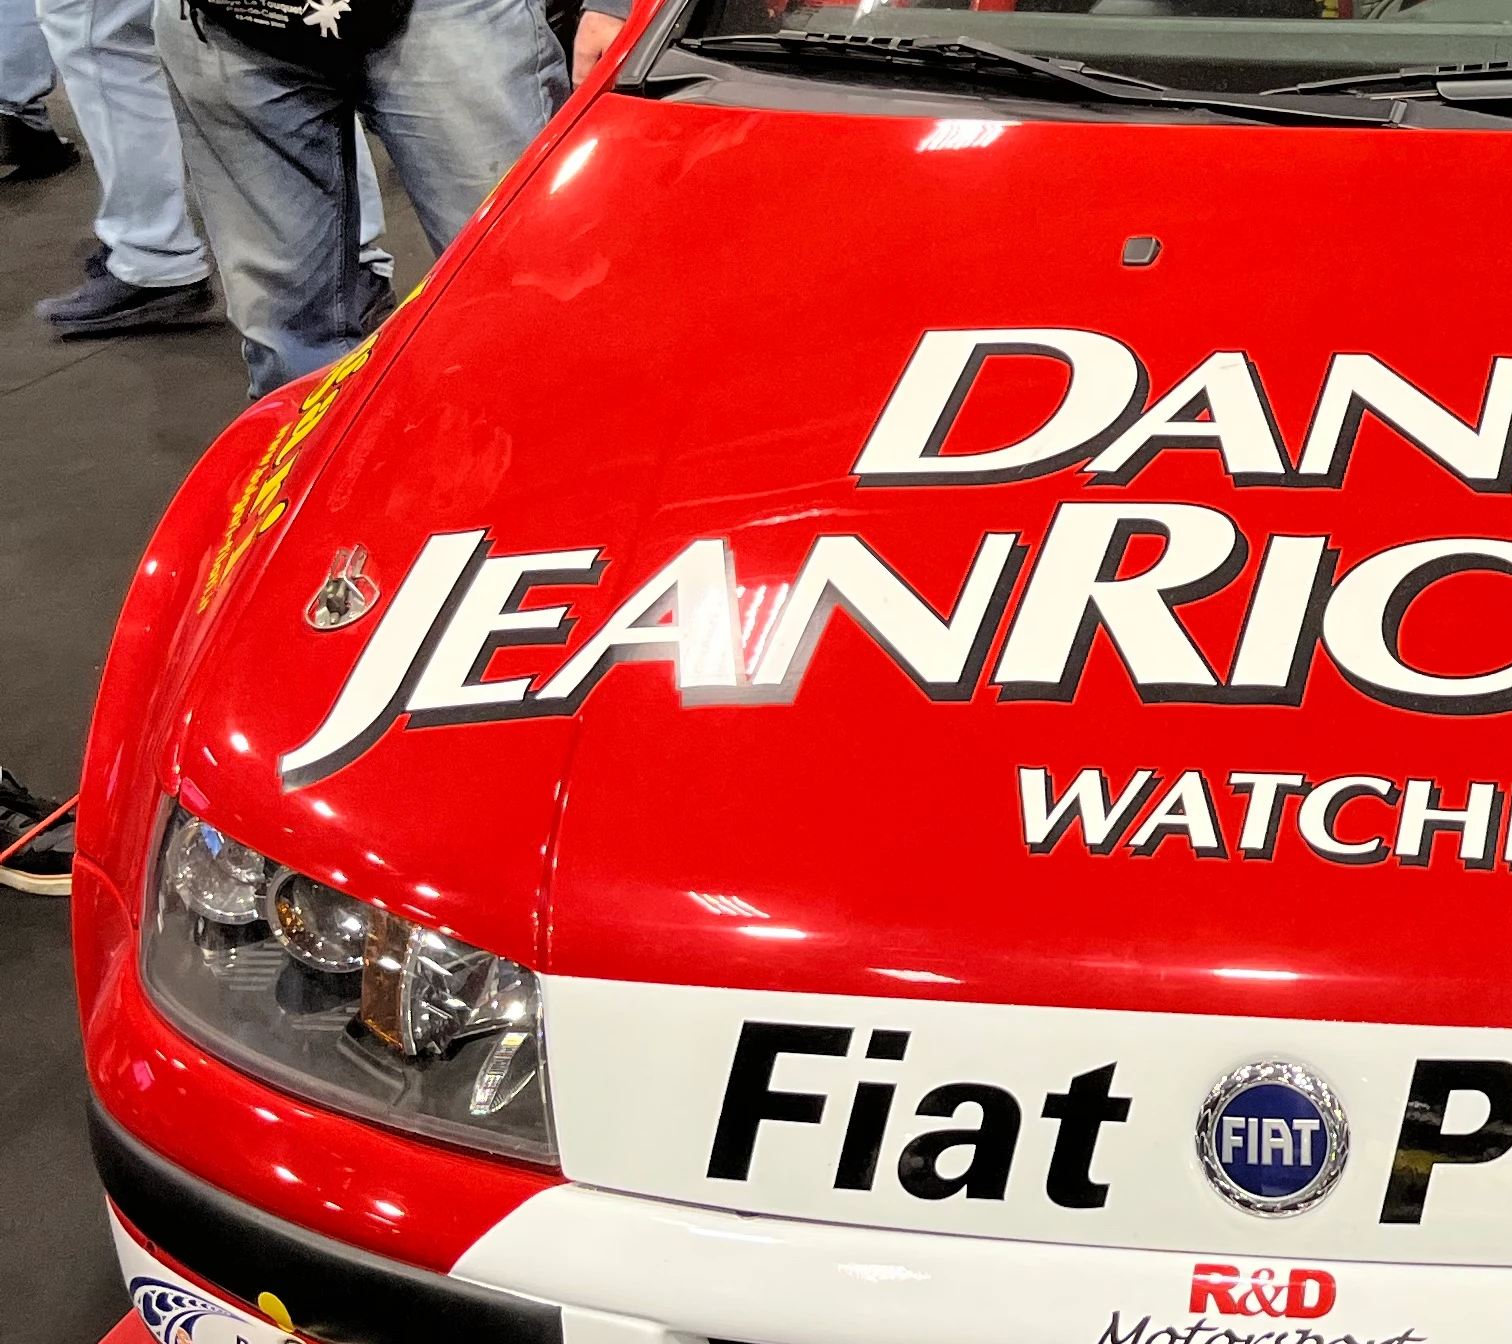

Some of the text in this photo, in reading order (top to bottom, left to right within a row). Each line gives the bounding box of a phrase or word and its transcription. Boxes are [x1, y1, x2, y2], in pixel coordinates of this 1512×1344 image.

[706, 1021, 1132, 1209] Fiat
[1221, 1117, 1320, 1166] FIAT
[1189, 1263, 1337, 1319] R&D
